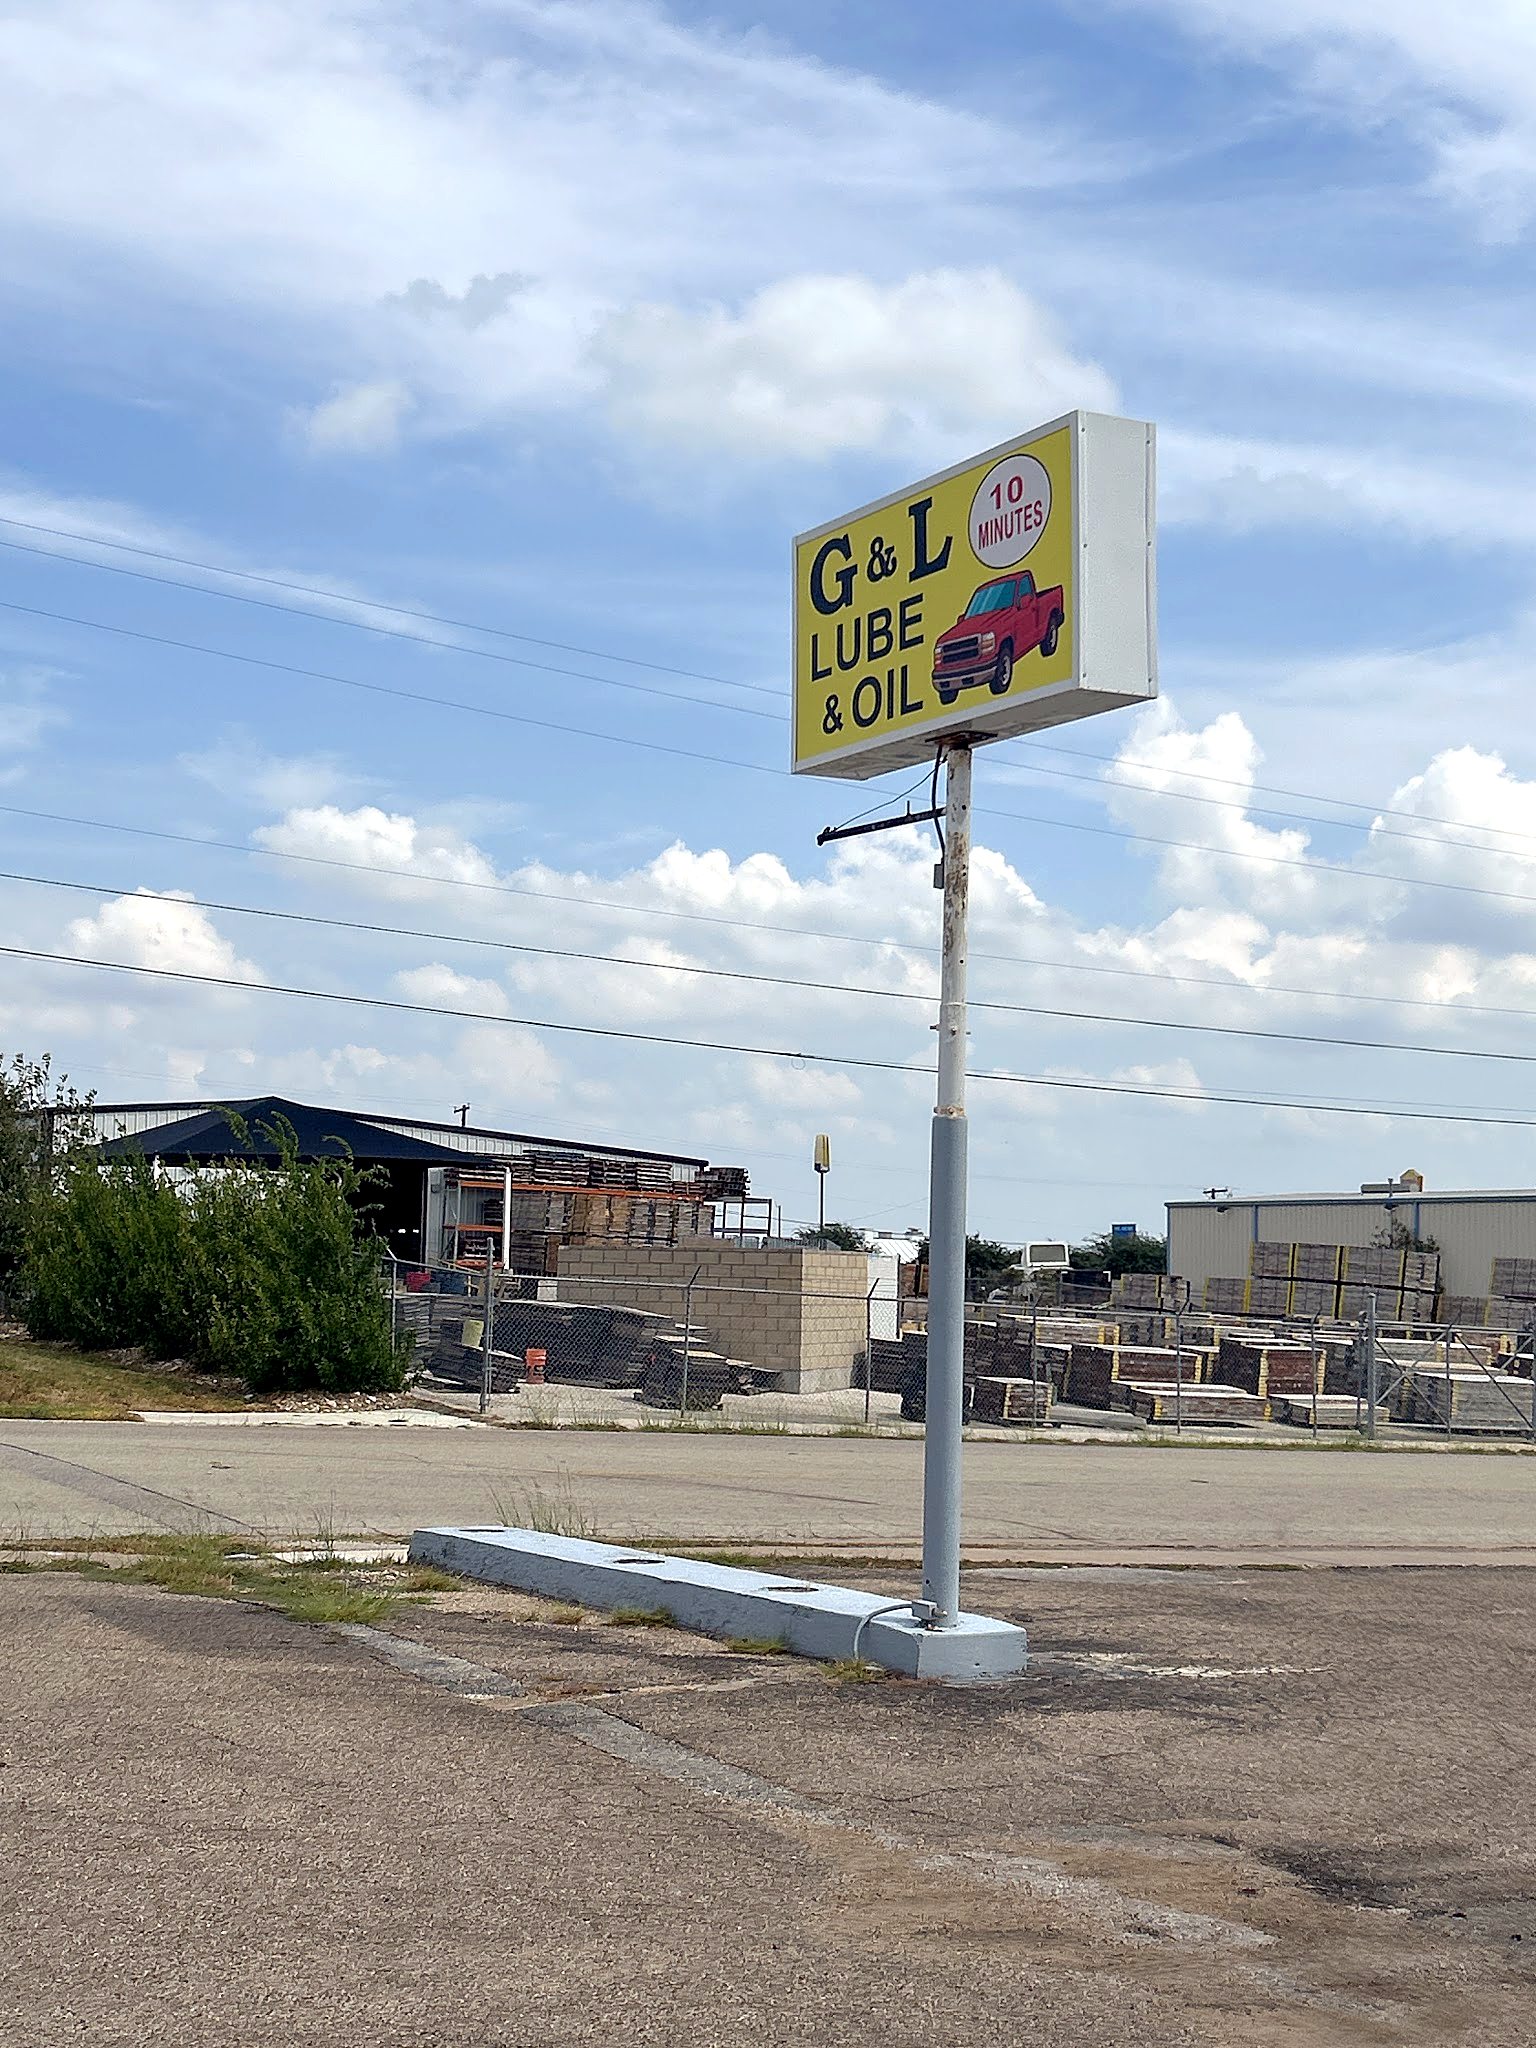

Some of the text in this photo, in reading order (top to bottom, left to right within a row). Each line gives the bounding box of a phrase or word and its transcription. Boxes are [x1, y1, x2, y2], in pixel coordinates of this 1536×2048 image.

[978, 501, 1043, 550] MINUTES
[990, 475, 1023, 510] 10
[810, 497, 953, 615] G & L
[811, 593, 924, 682] LUBE
[823, 665, 923, 734] & OIL
